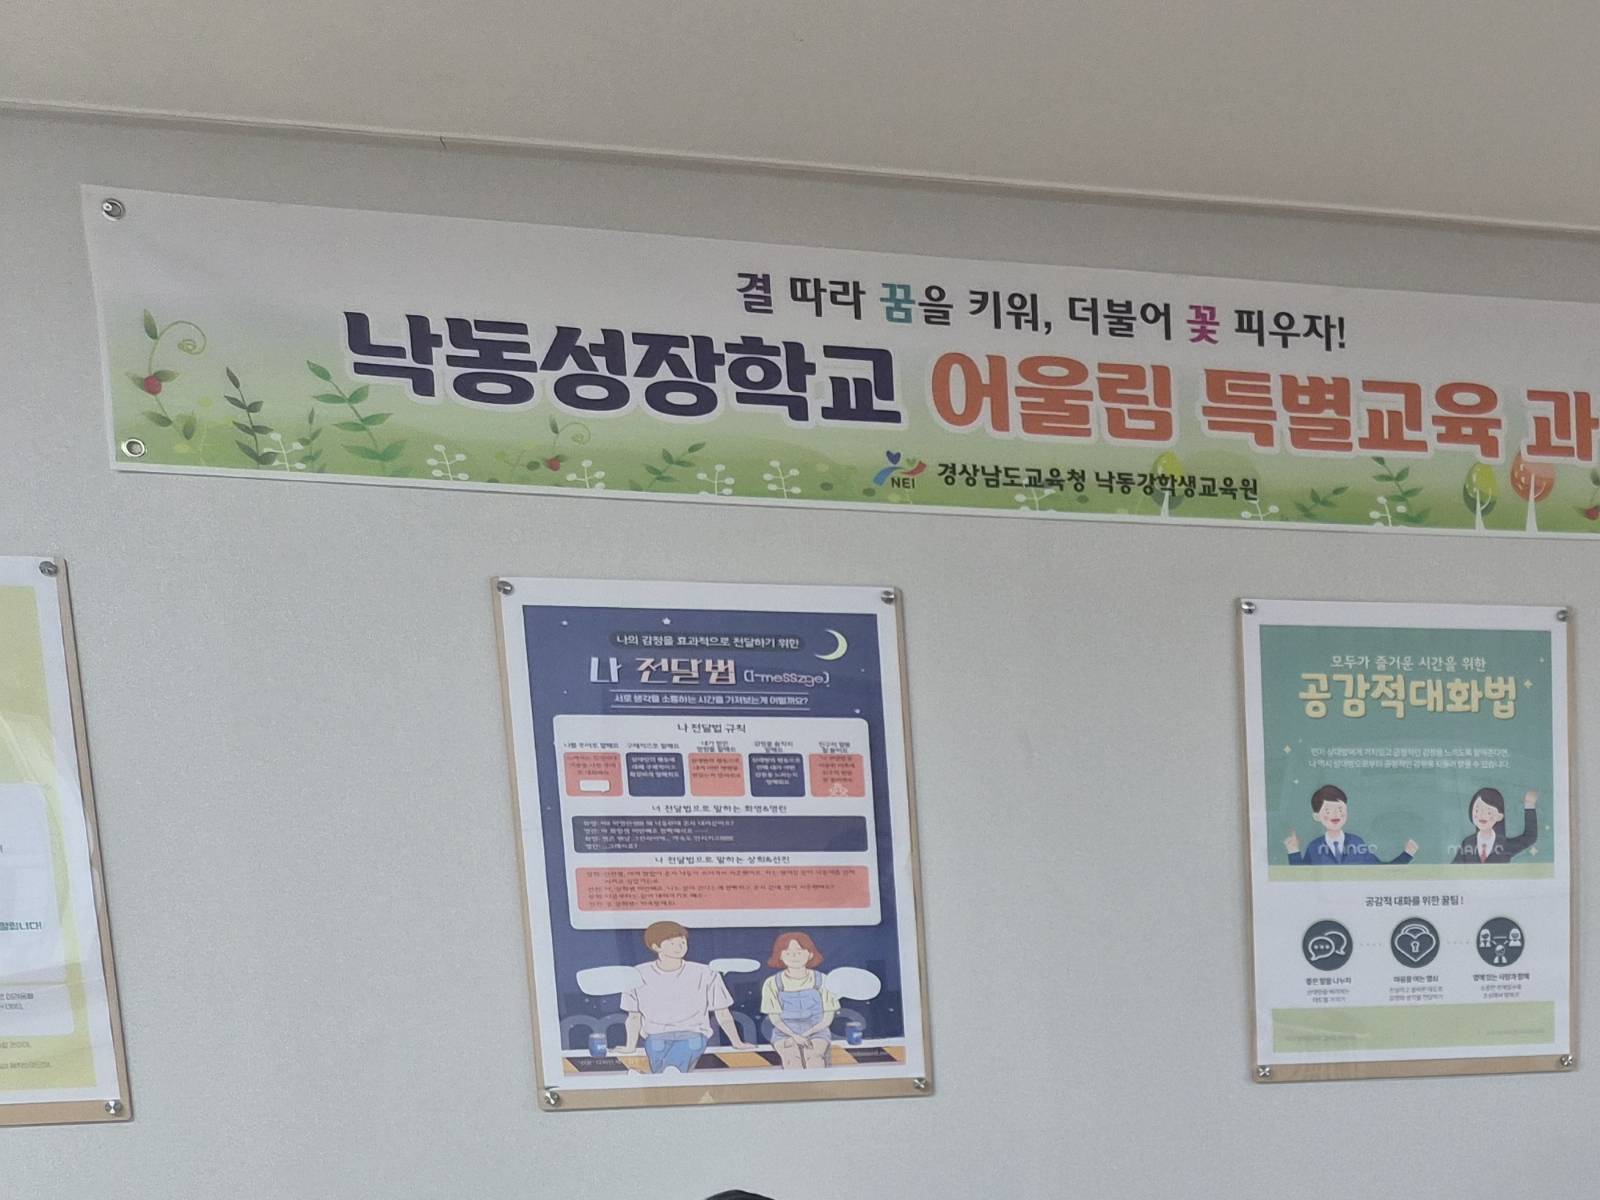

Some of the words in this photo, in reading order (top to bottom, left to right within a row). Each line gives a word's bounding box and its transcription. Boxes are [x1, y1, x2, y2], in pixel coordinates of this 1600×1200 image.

[736, 272, 773, 314] 결
[789, 277, 866, 320] 따라
[879, 282, 954, 326] 꿈을
[968, 289, 1051, 335] 키워,
[1068, 296, 1172, 340] 더불어
[1186, 304, 1221, 345] 꽃
[1234, 309, 1346, 352] 피우자!
[343, 310, 902, 426] 낙동성장학교
[931, 351, 1173, 442] 어울림
[1202, 367, 1502, 459] 특별교육
[891, 477, 916, 489] NEI
[937, 462, 1086, 493] 경상남도교육청
[1095, 471, 1259, 501] 낙동강학생교육원
[616, 636, 639, 646] 나의
[641, 636, 674, 647] 감정을
[677, 636, 731, 648] 효과적으로
[733, 637, 776, 649] 전달하기
[778, 638, 799, 650] 위한
[590, 656, 623, 683] 나
[635, 657, 737, 685] 전달법
[1330, 655, 1370, 670] 모두가
[1375, 656, 1415, 671] 즐거운
[1419, 656, 1458, 672] 시간을
[1462, 656, 1487, 672] 위한
[1299, 672, 1517, 719] 공감적대화법
[677, 723, 688, 733] 나
[691, 723, 722, 734] 전달법
[725, 723, 747, 734] 규칙
[1365, 896, 1393, 907] 공감적
[1393, 896, 1421, 907] 대화를
[1422, 896, 1440, 907] 위한
